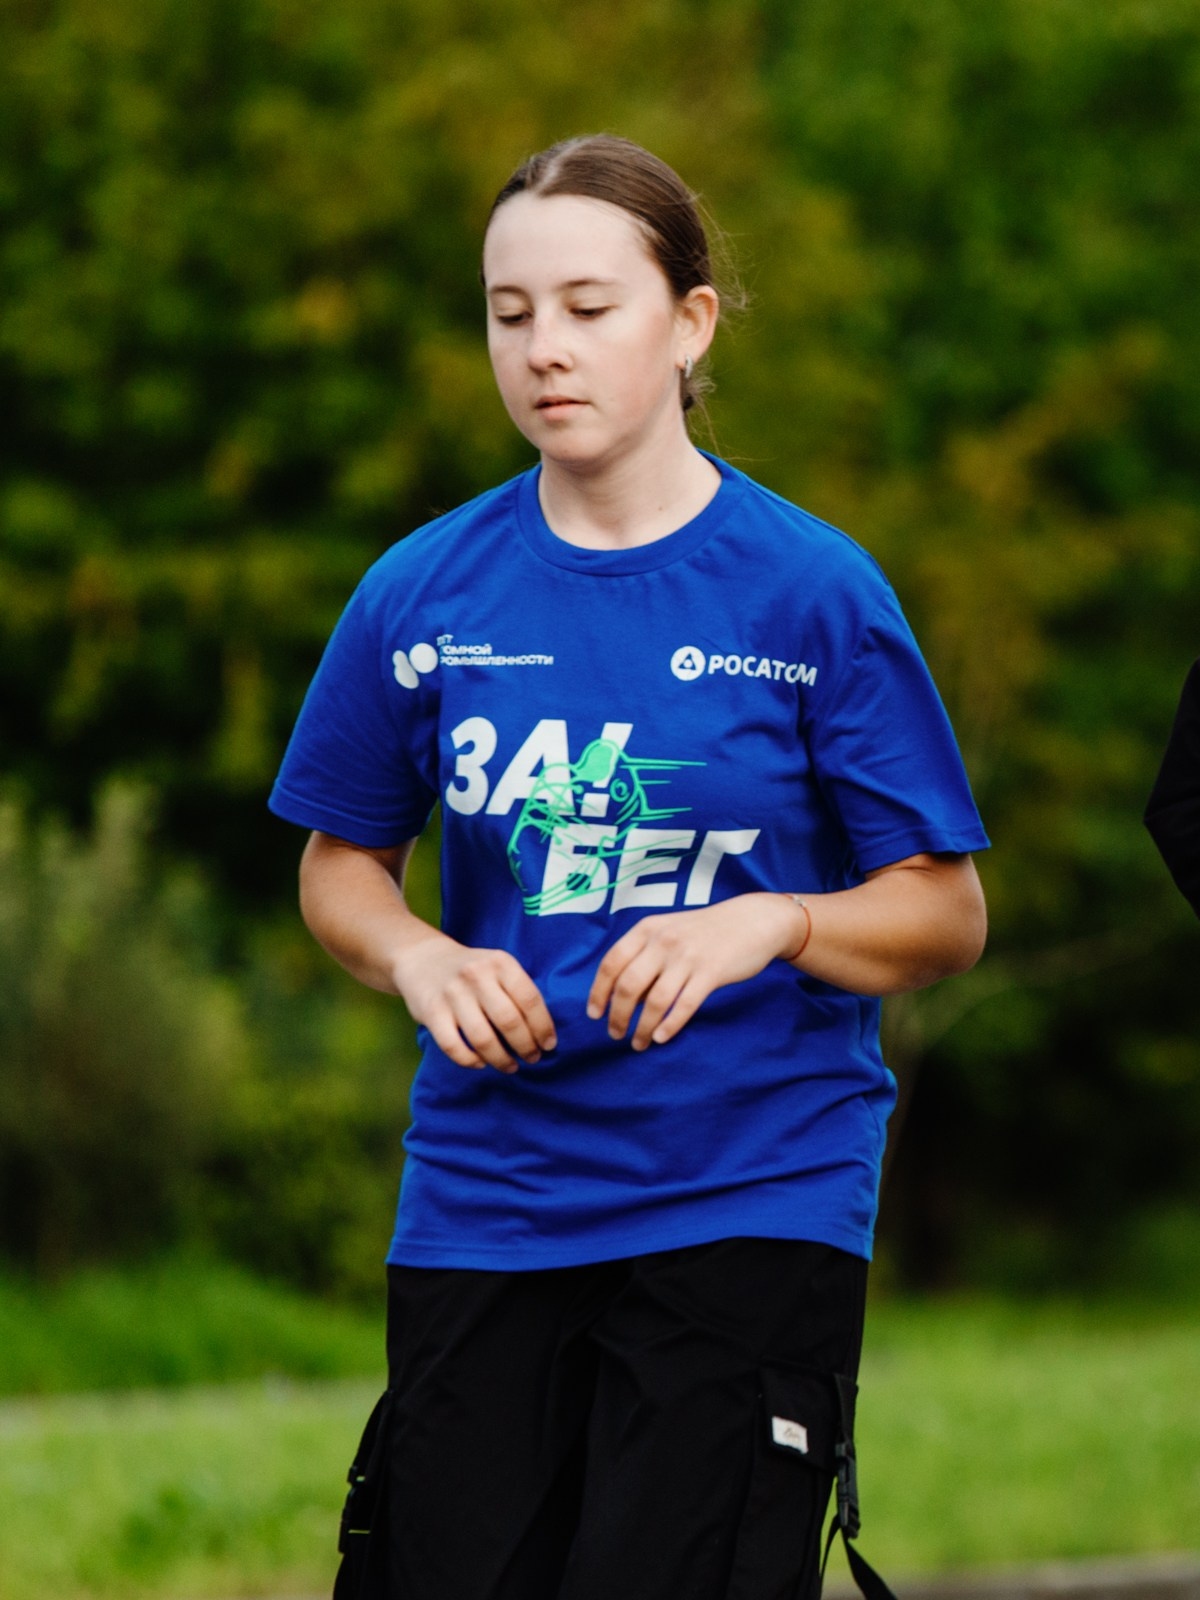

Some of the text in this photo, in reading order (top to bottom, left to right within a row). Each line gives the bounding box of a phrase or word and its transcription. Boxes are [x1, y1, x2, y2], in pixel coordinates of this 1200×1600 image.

[708, 654, 818, 687] РОСАТОМ
[445, 716, 634, 817] ЗА!
[538, 823, 761, 916] БЕГ
